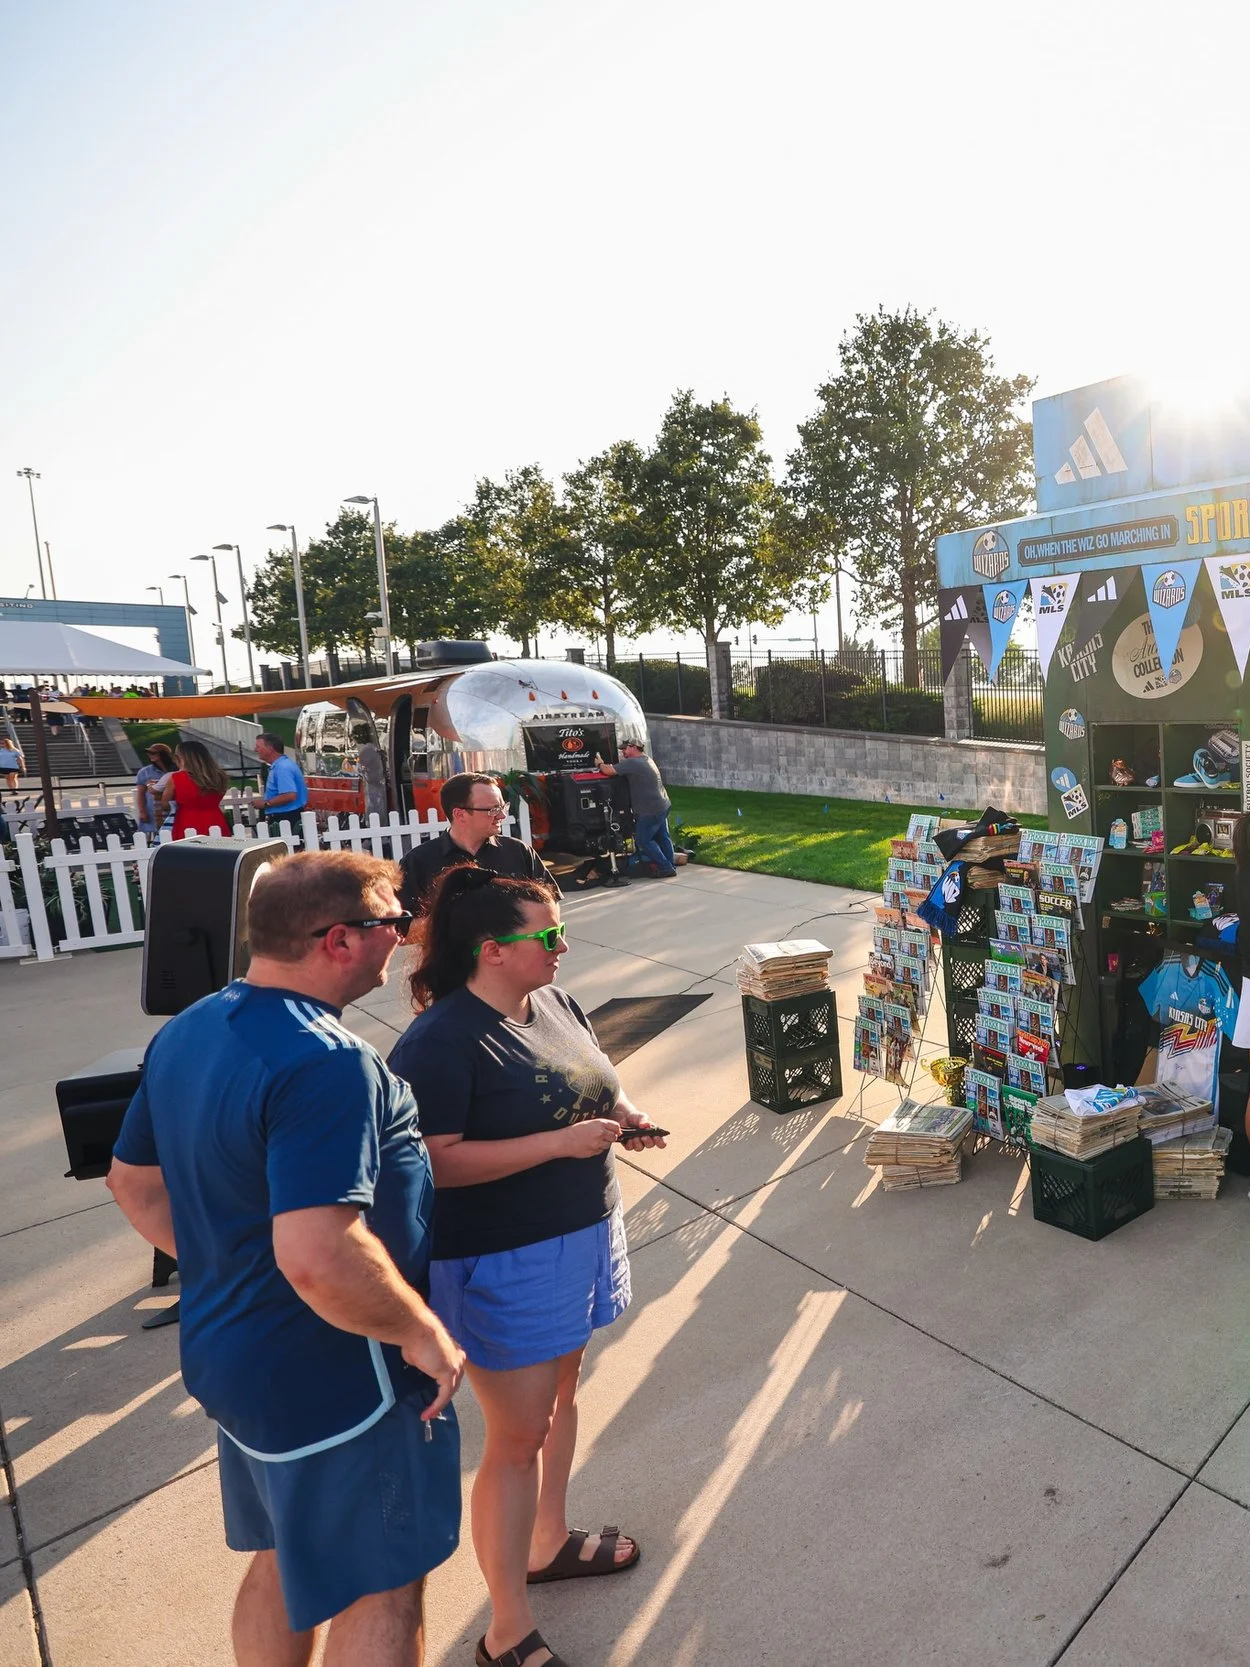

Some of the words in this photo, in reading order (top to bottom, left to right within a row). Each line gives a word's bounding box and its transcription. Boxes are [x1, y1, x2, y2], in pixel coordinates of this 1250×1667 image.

[1060, 540, 1077, 553] THE
[1077, 537, 1095, 551] WIZ
[1096, 535, 1109, 549] GO
[1110, 527, 1159, 547] MARCHING
[1160, 524, 1171, 540] IN
[973, 552, 1009, 578] WIZARDS
[1153, 582, 1186, 607] WIZARDS
[1039, 605, 1064, 614] MLS
[1070, 652, 1097, 683] CITY
[533, 711, 605, 720] AIRSTREAM
[559, 728, 585, 737] Tito's
[558, 751, 590, 760] Handmade
[1068, 802, 1087, 817] MLS
[1039, 895, 1072, 909] SOCCER
